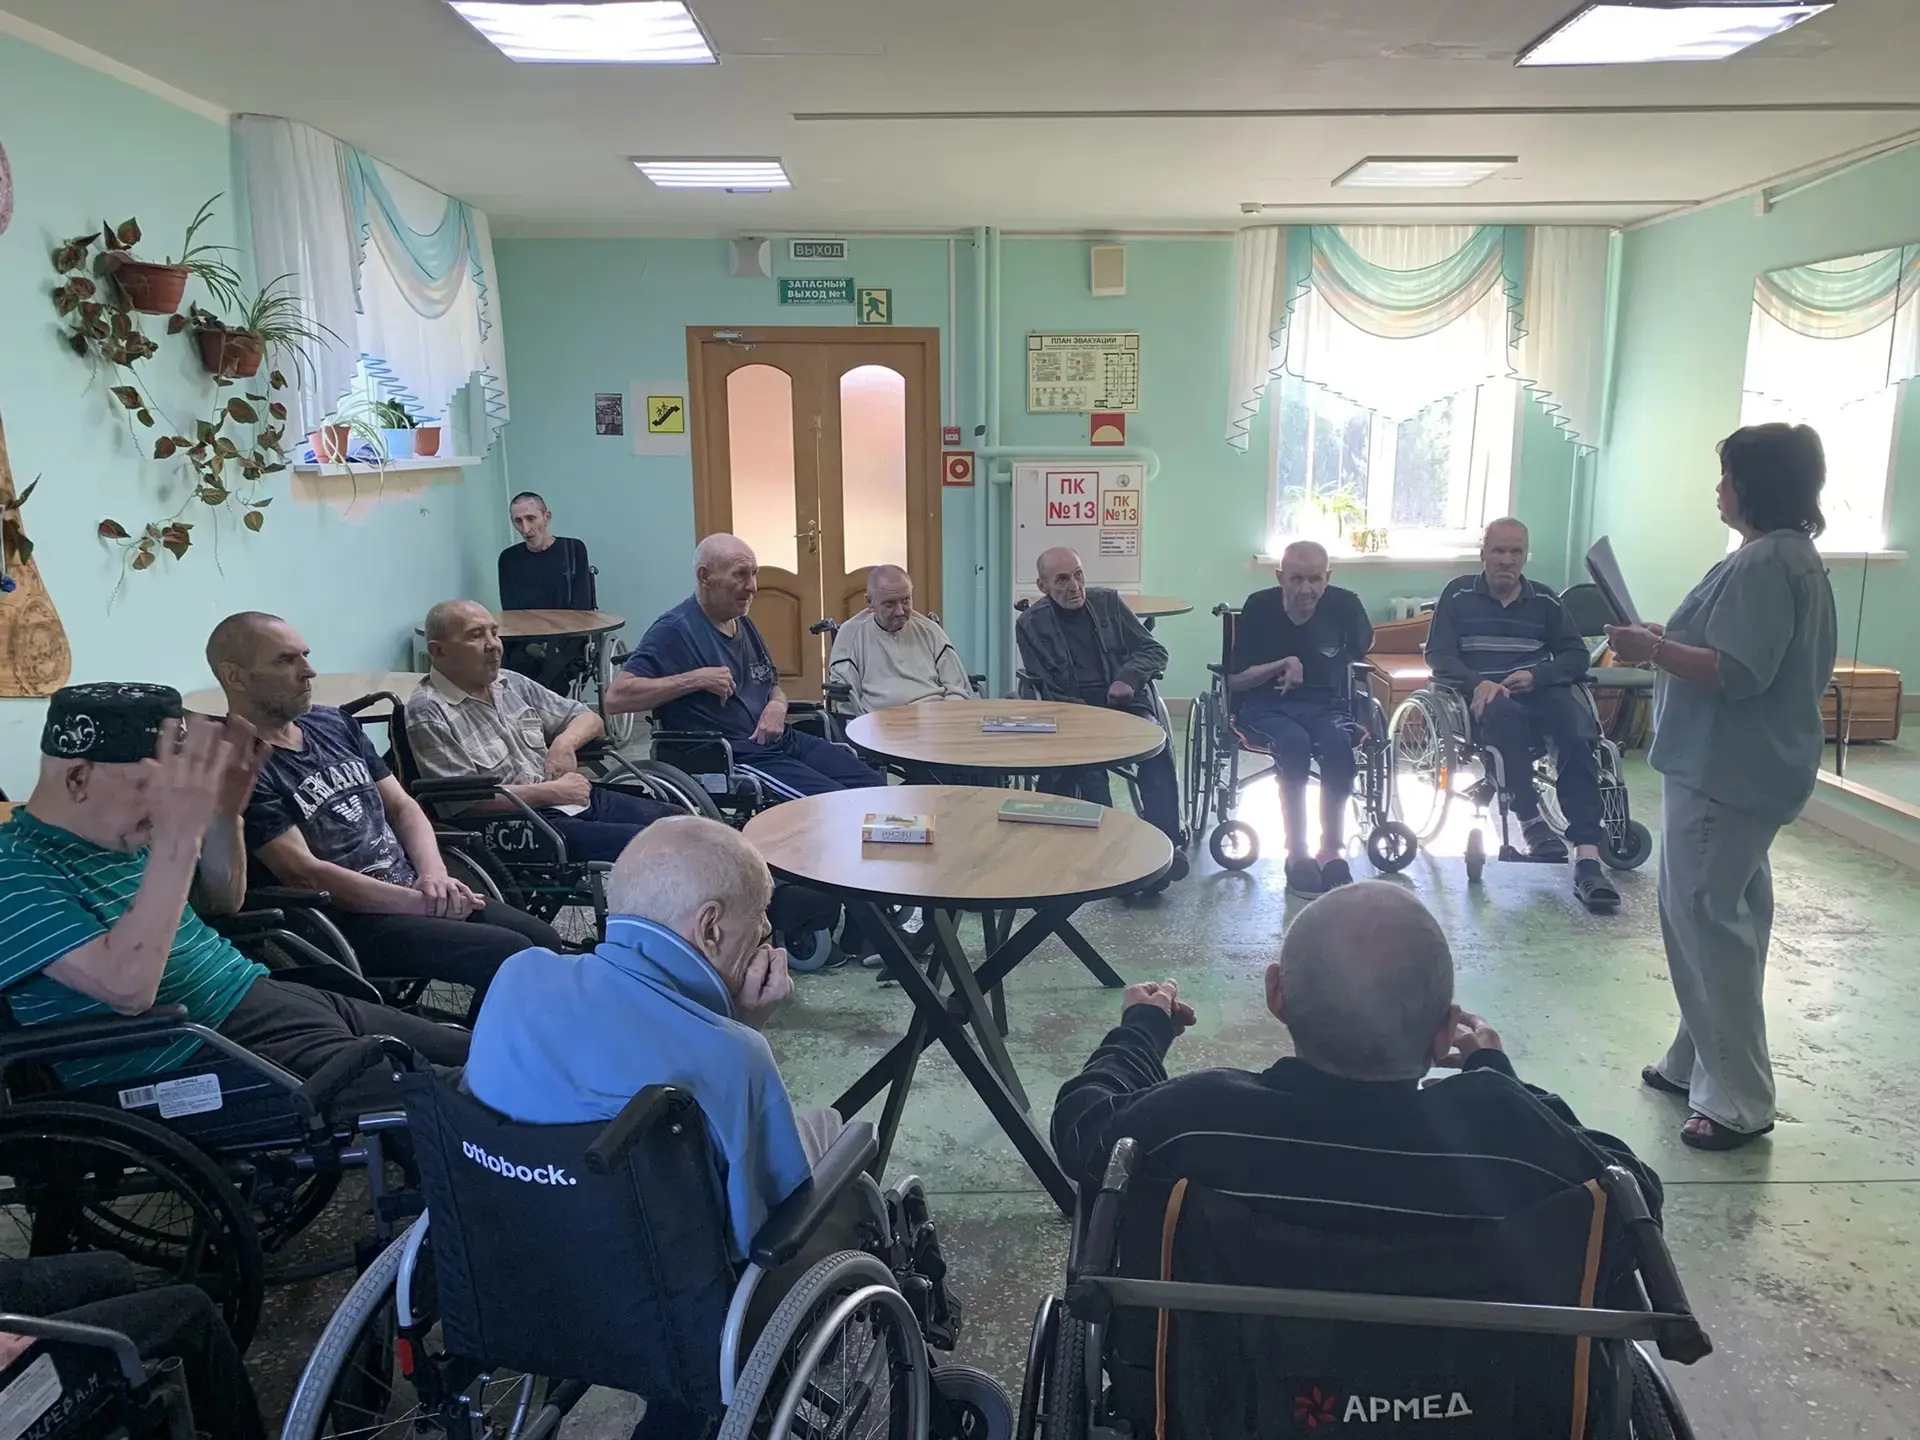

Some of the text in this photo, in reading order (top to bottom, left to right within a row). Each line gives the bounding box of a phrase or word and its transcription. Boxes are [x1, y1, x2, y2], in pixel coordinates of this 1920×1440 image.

[796, 245, 842, 256] ВЫХОД
[787, 278, 846, 288] ЗАПАСНЫЙ
[787, 290, 846, 299] ВЫХОД №1
[1061, 478, 1085, 494] ПК
[1113, 495, 1130, 507] ПК
[1049, 501, 1095, 519] №13
[1105, 508, 1137, 520] №13
[1343, 1392, 1473, 1422] АРМЕД
